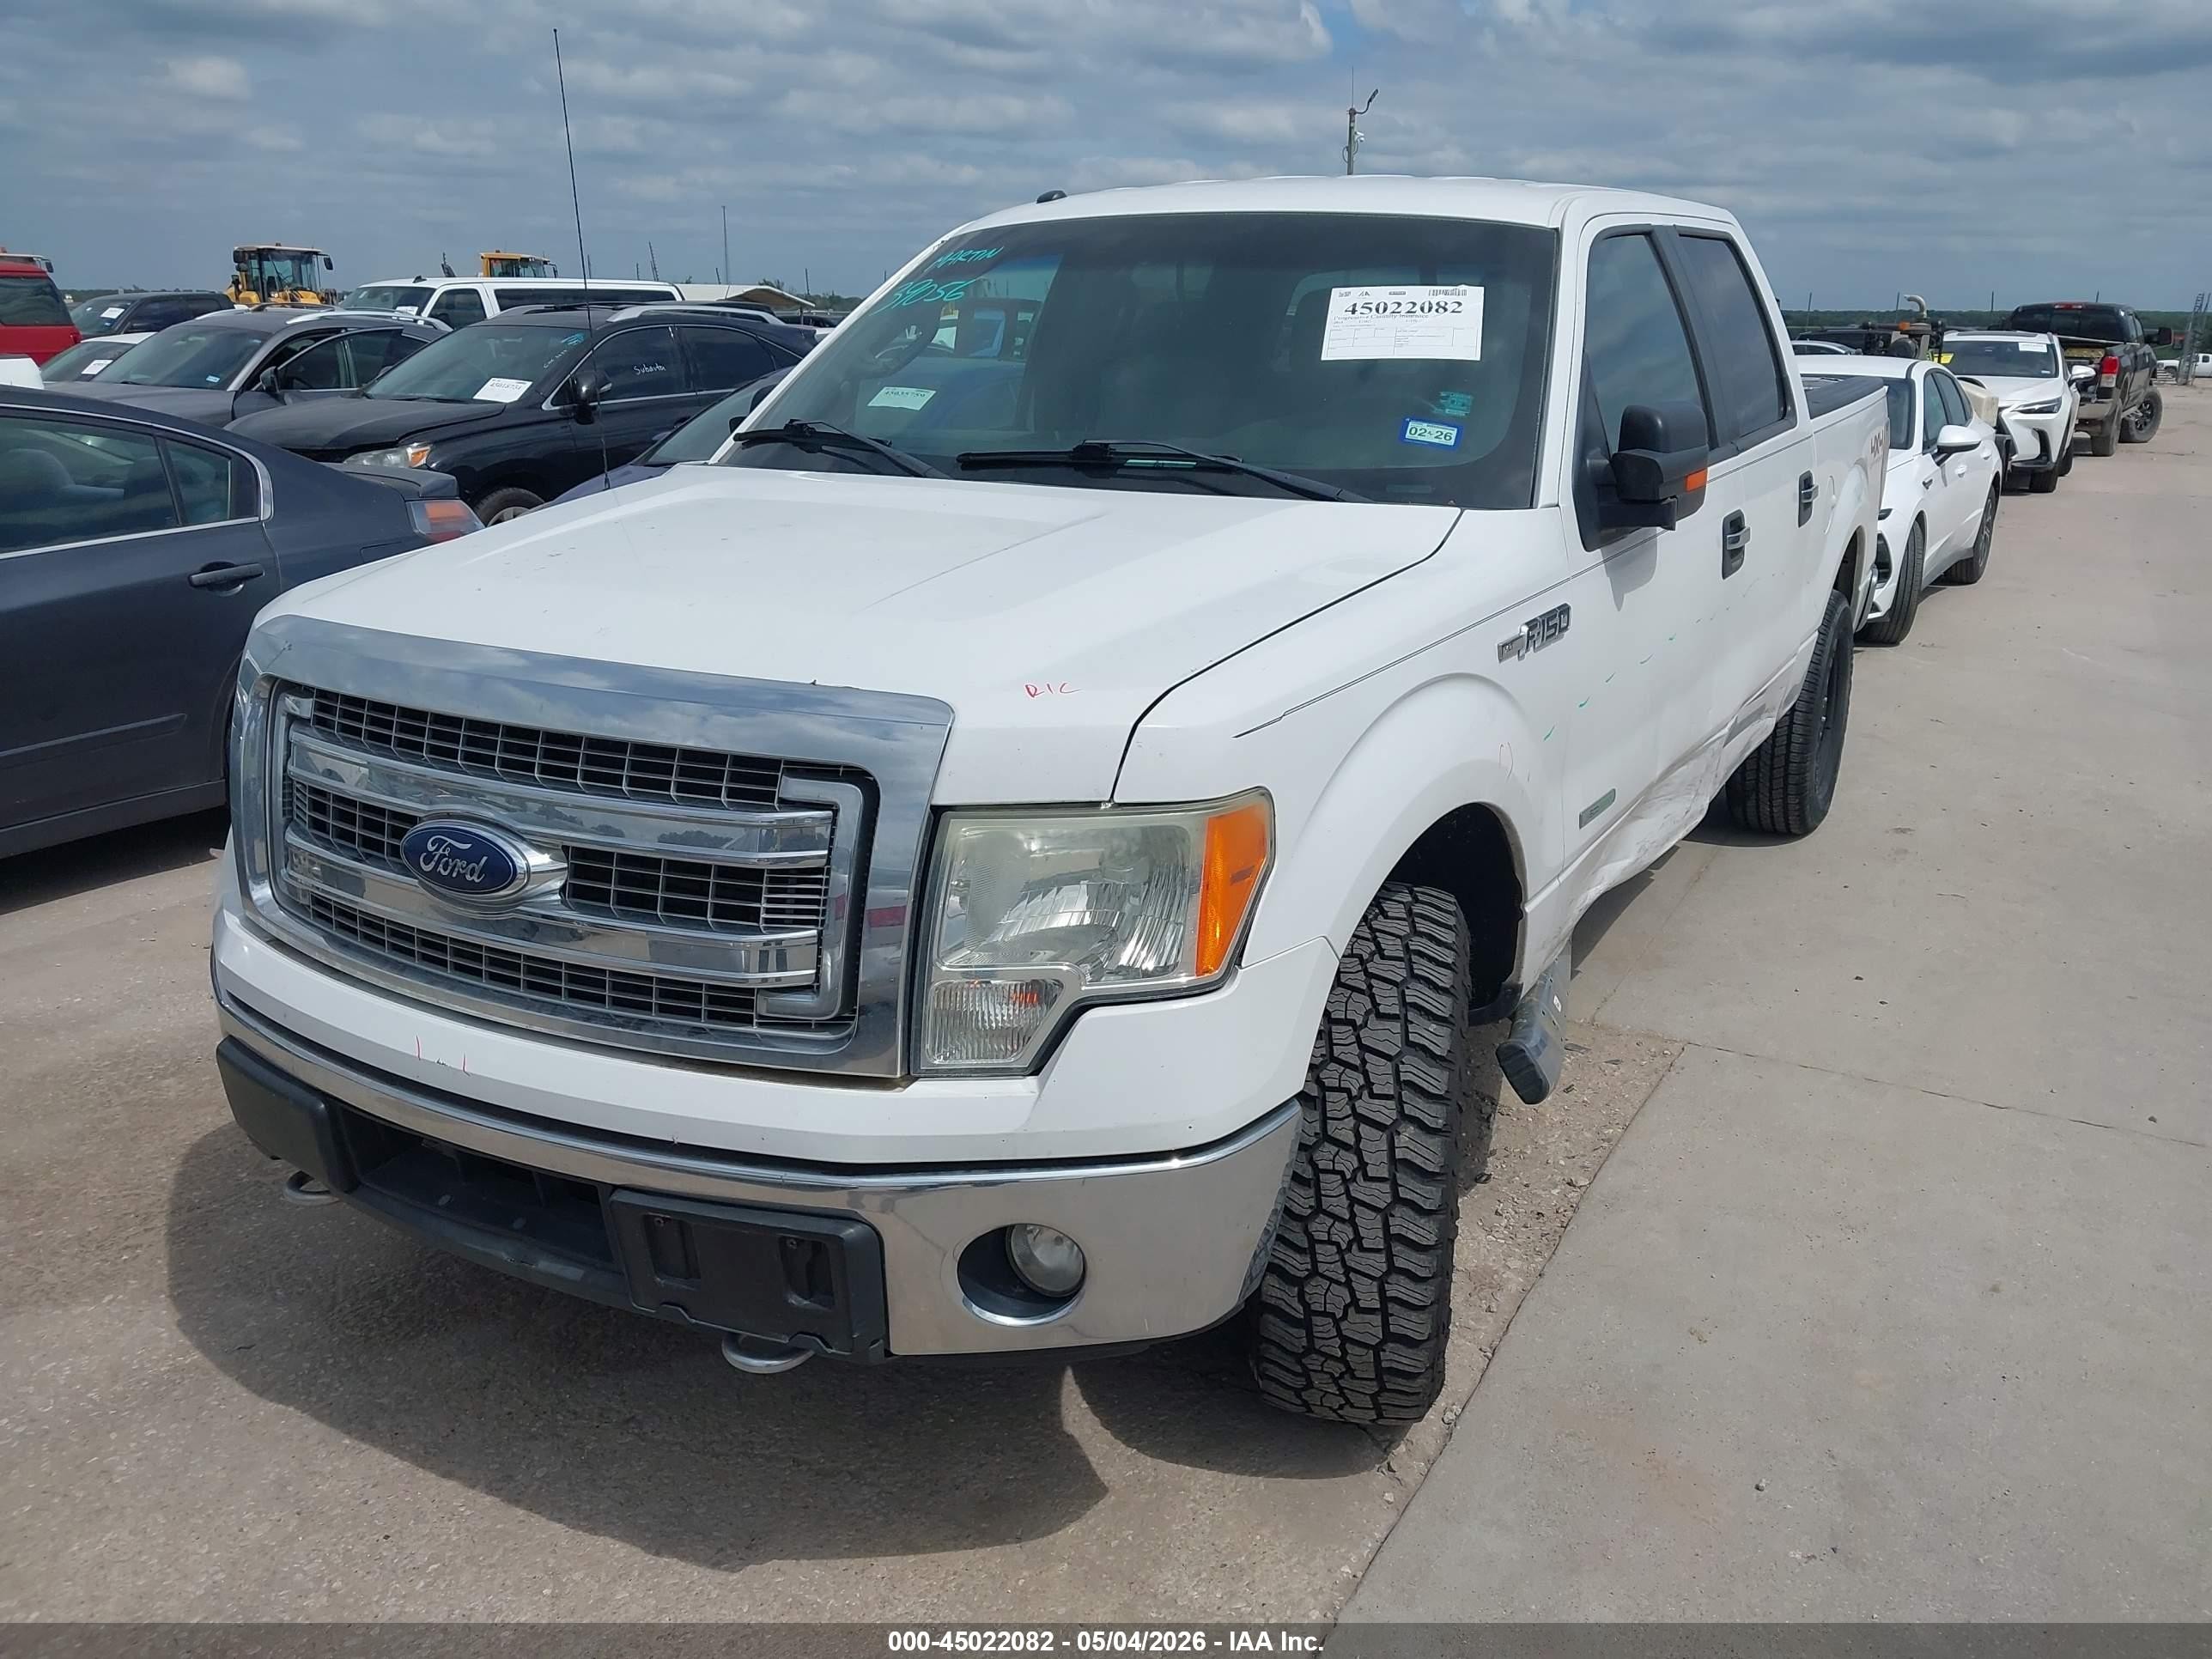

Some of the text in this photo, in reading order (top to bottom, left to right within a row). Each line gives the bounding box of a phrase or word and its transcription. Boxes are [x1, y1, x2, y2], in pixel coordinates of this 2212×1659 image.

[923, 246, 1004, 272] MARTIN
[1344, 301, 1463, 315] 45022082
[1408, 426, 1427, 437] 02
[1434, 430, 1454, 441] 26
[419, 835, 489, 883] Ford
